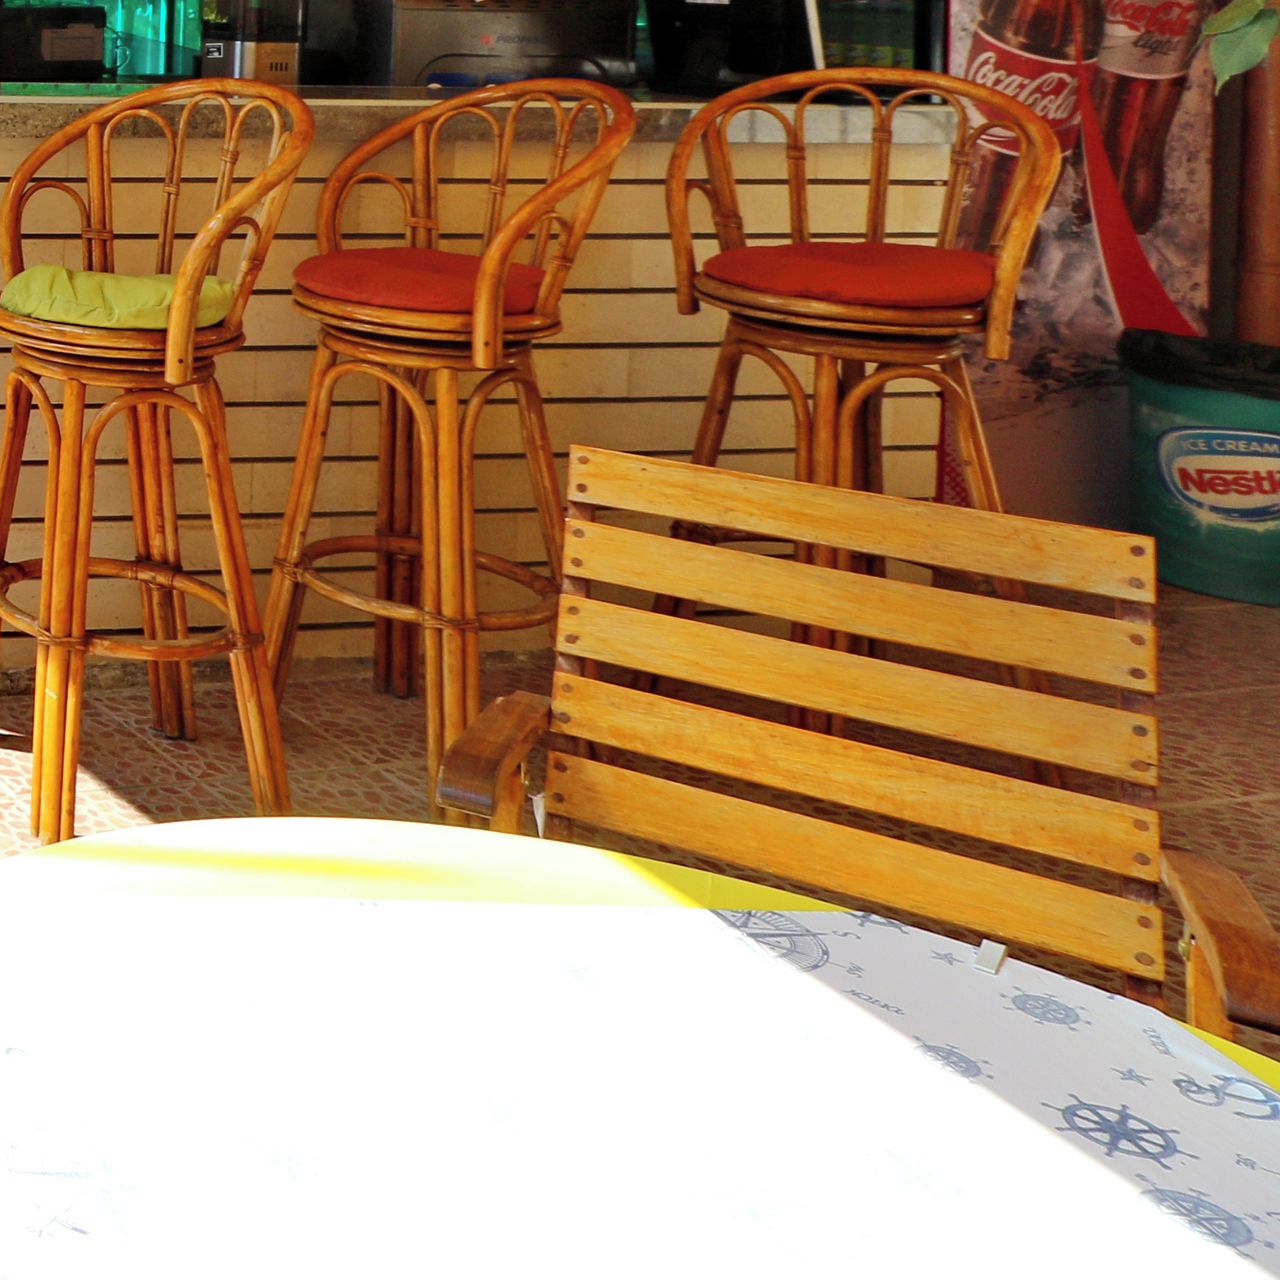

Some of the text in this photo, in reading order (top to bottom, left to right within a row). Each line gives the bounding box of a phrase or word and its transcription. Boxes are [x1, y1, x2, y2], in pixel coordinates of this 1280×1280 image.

[1183, 439, 1280, 453] ICE CREAM
[1178, 466, 1280, 496] Nestl
